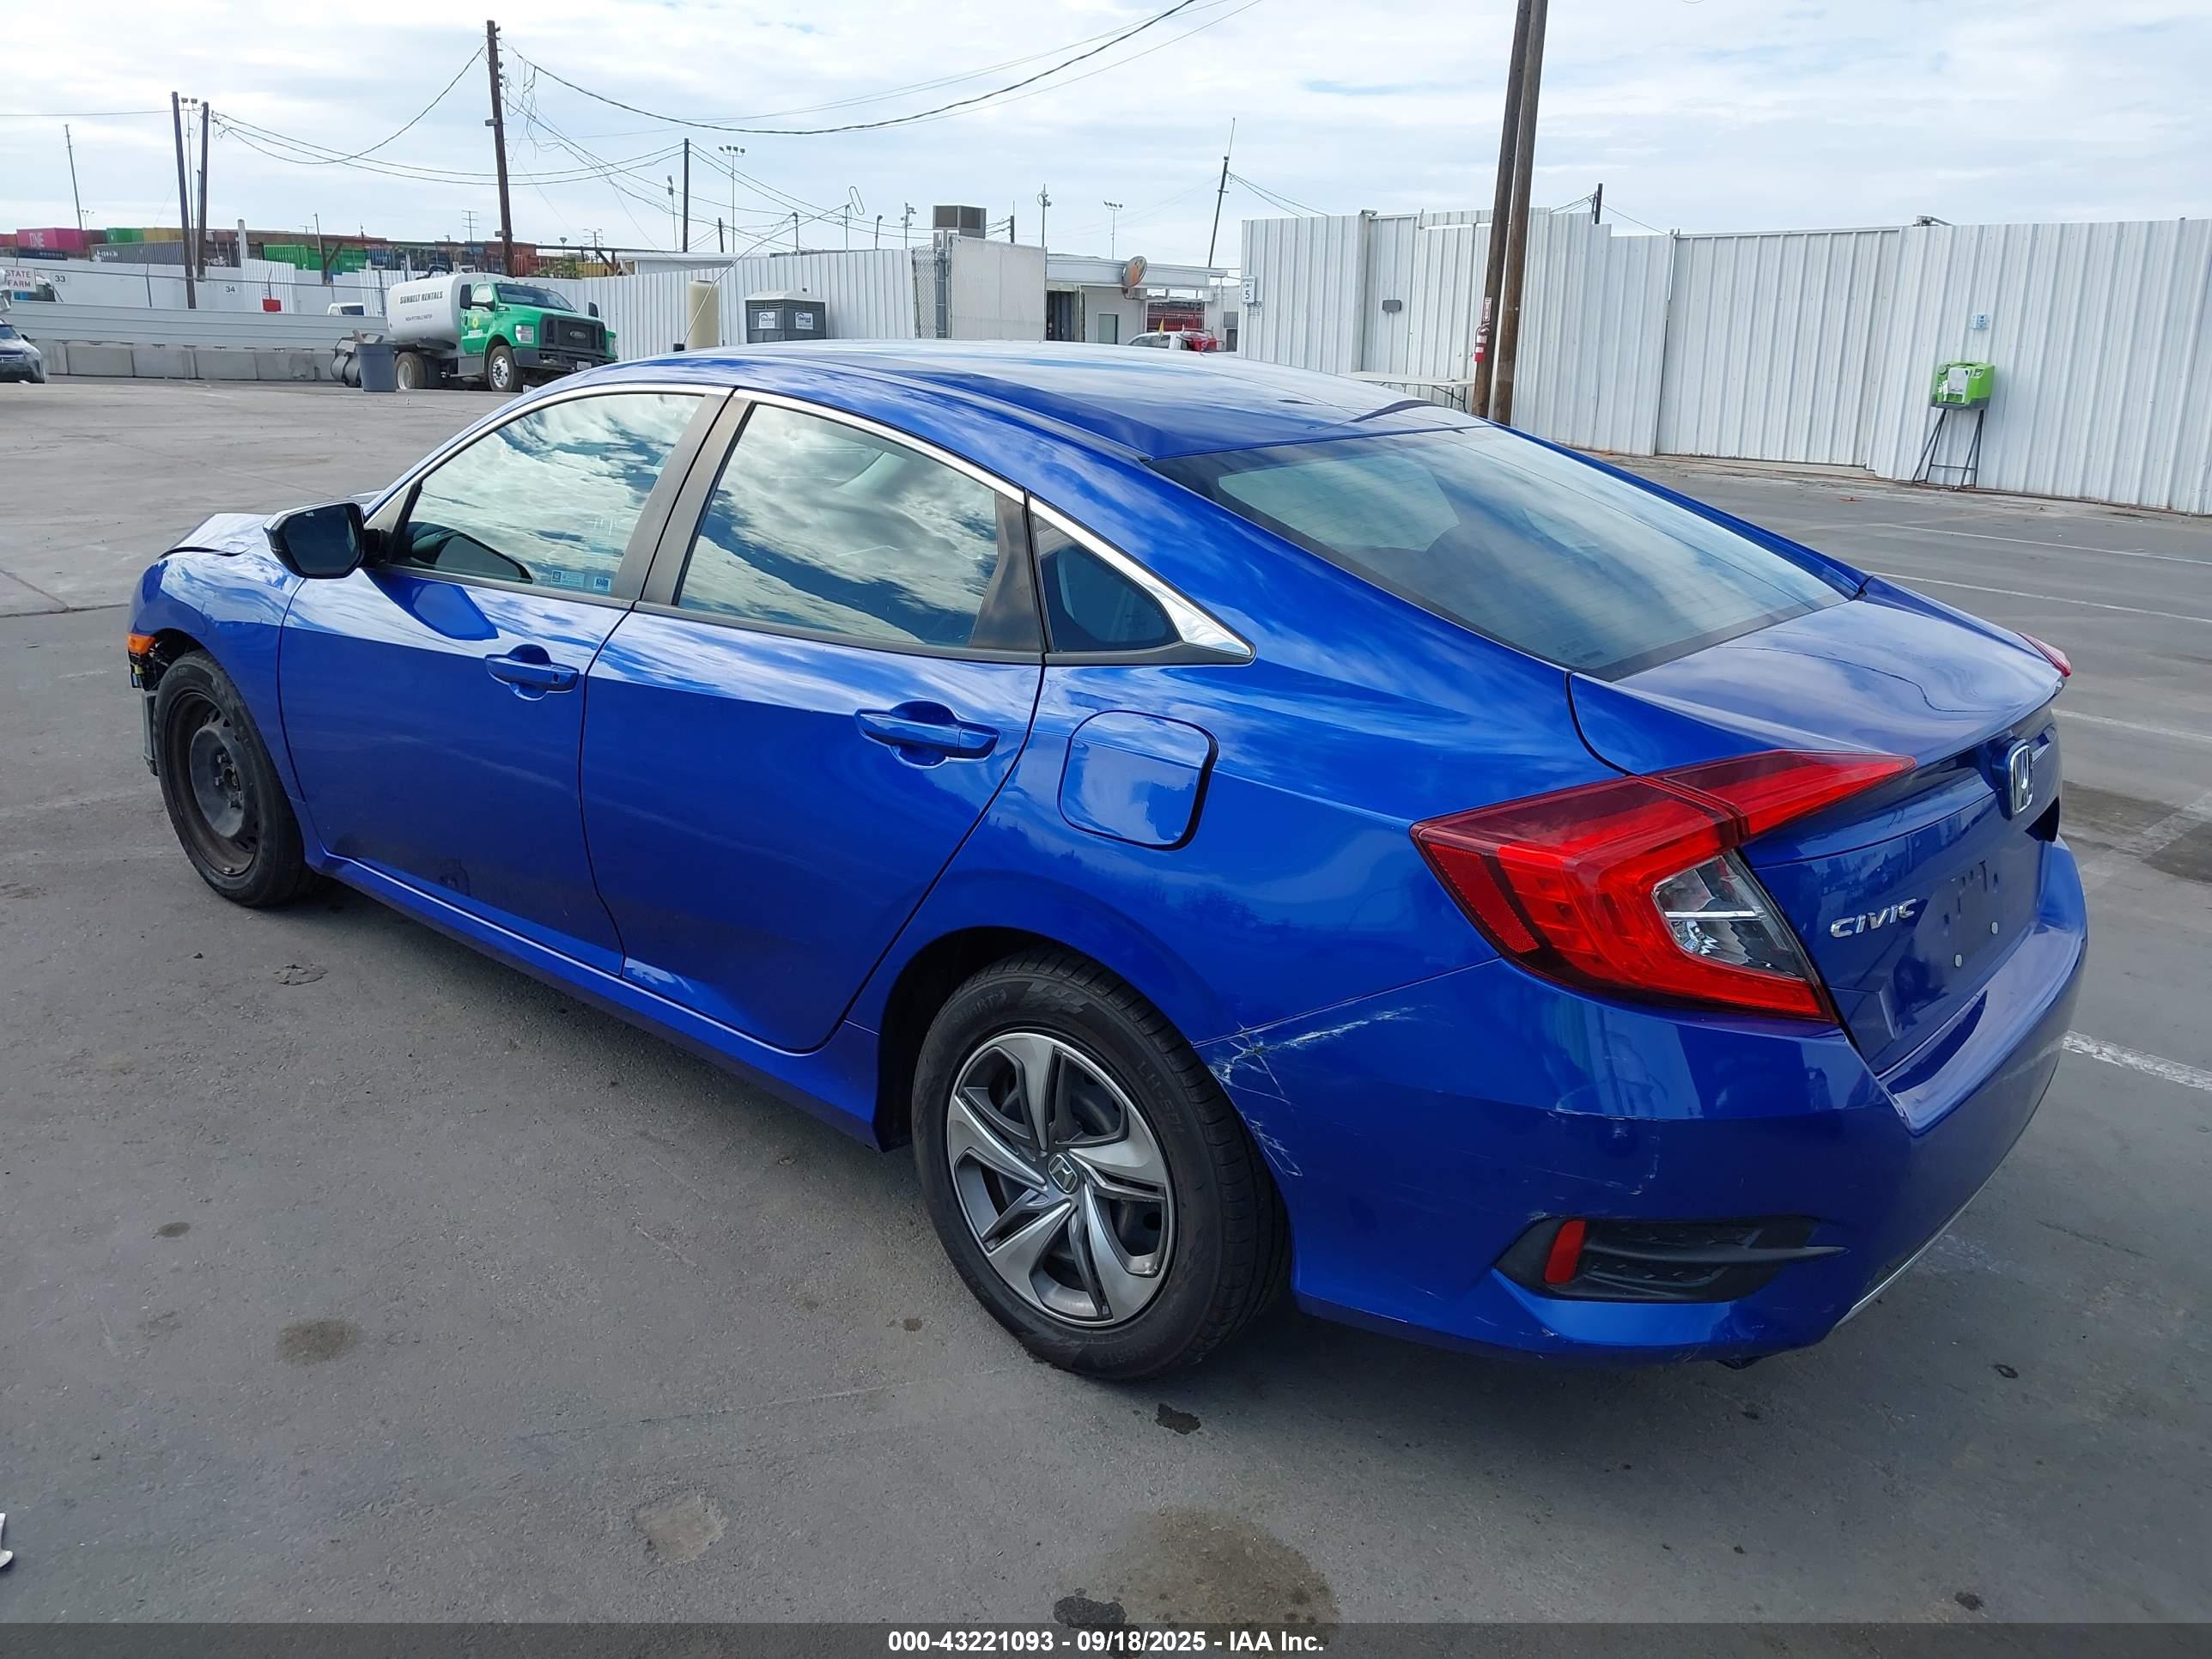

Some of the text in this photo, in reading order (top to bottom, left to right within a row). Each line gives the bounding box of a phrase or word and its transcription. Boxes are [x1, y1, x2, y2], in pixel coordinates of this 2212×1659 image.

[5, 270, 30, 278] STATE
[399, 291, 443, 304] SUNBELT RENTALS
[1245, 289, 1250, 299] 5
[1830, 898, 1917, 938] CIVIC
